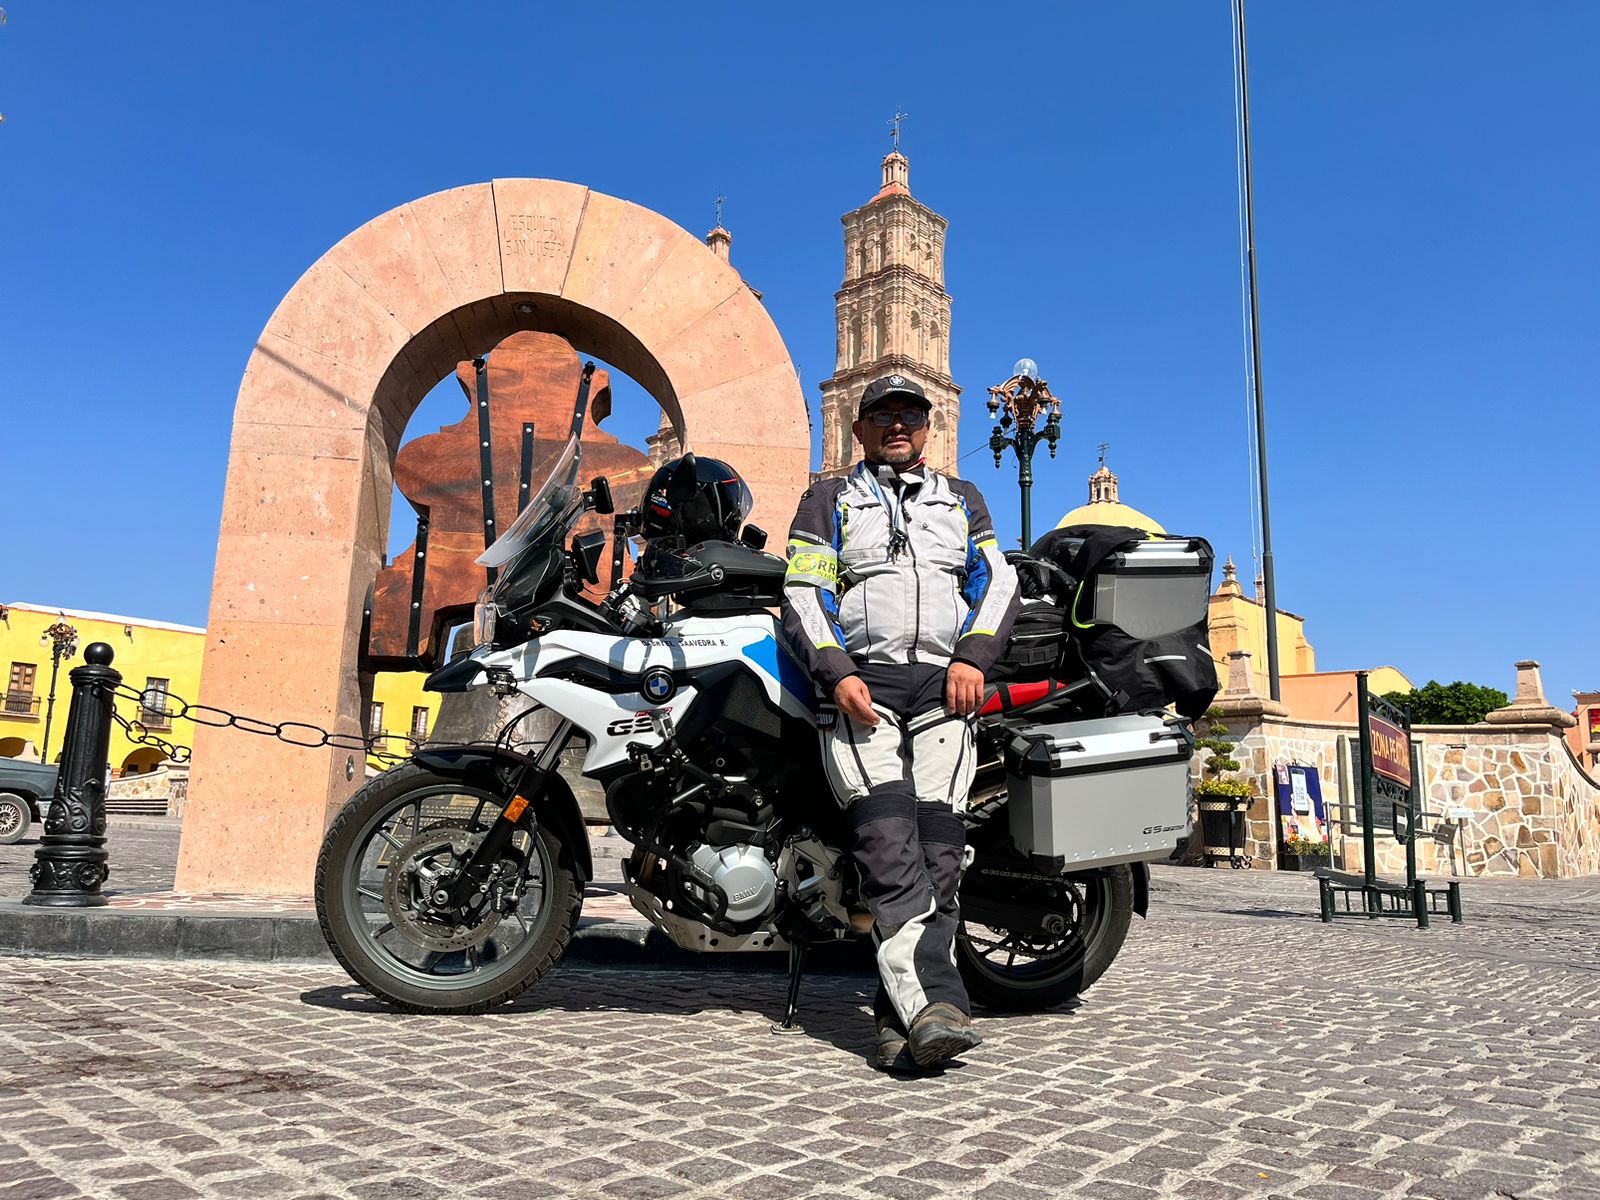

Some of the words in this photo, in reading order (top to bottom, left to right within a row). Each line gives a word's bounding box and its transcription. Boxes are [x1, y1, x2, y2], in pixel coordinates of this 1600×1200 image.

[678, 639, 717, 647] SAAVEDRA
[607, 717, 655, 737] GS
[1371, 729, 1390, 761] ZONA
[1143, 825, 1163, 835] GS
[732, 886, 756, 901] BMW
